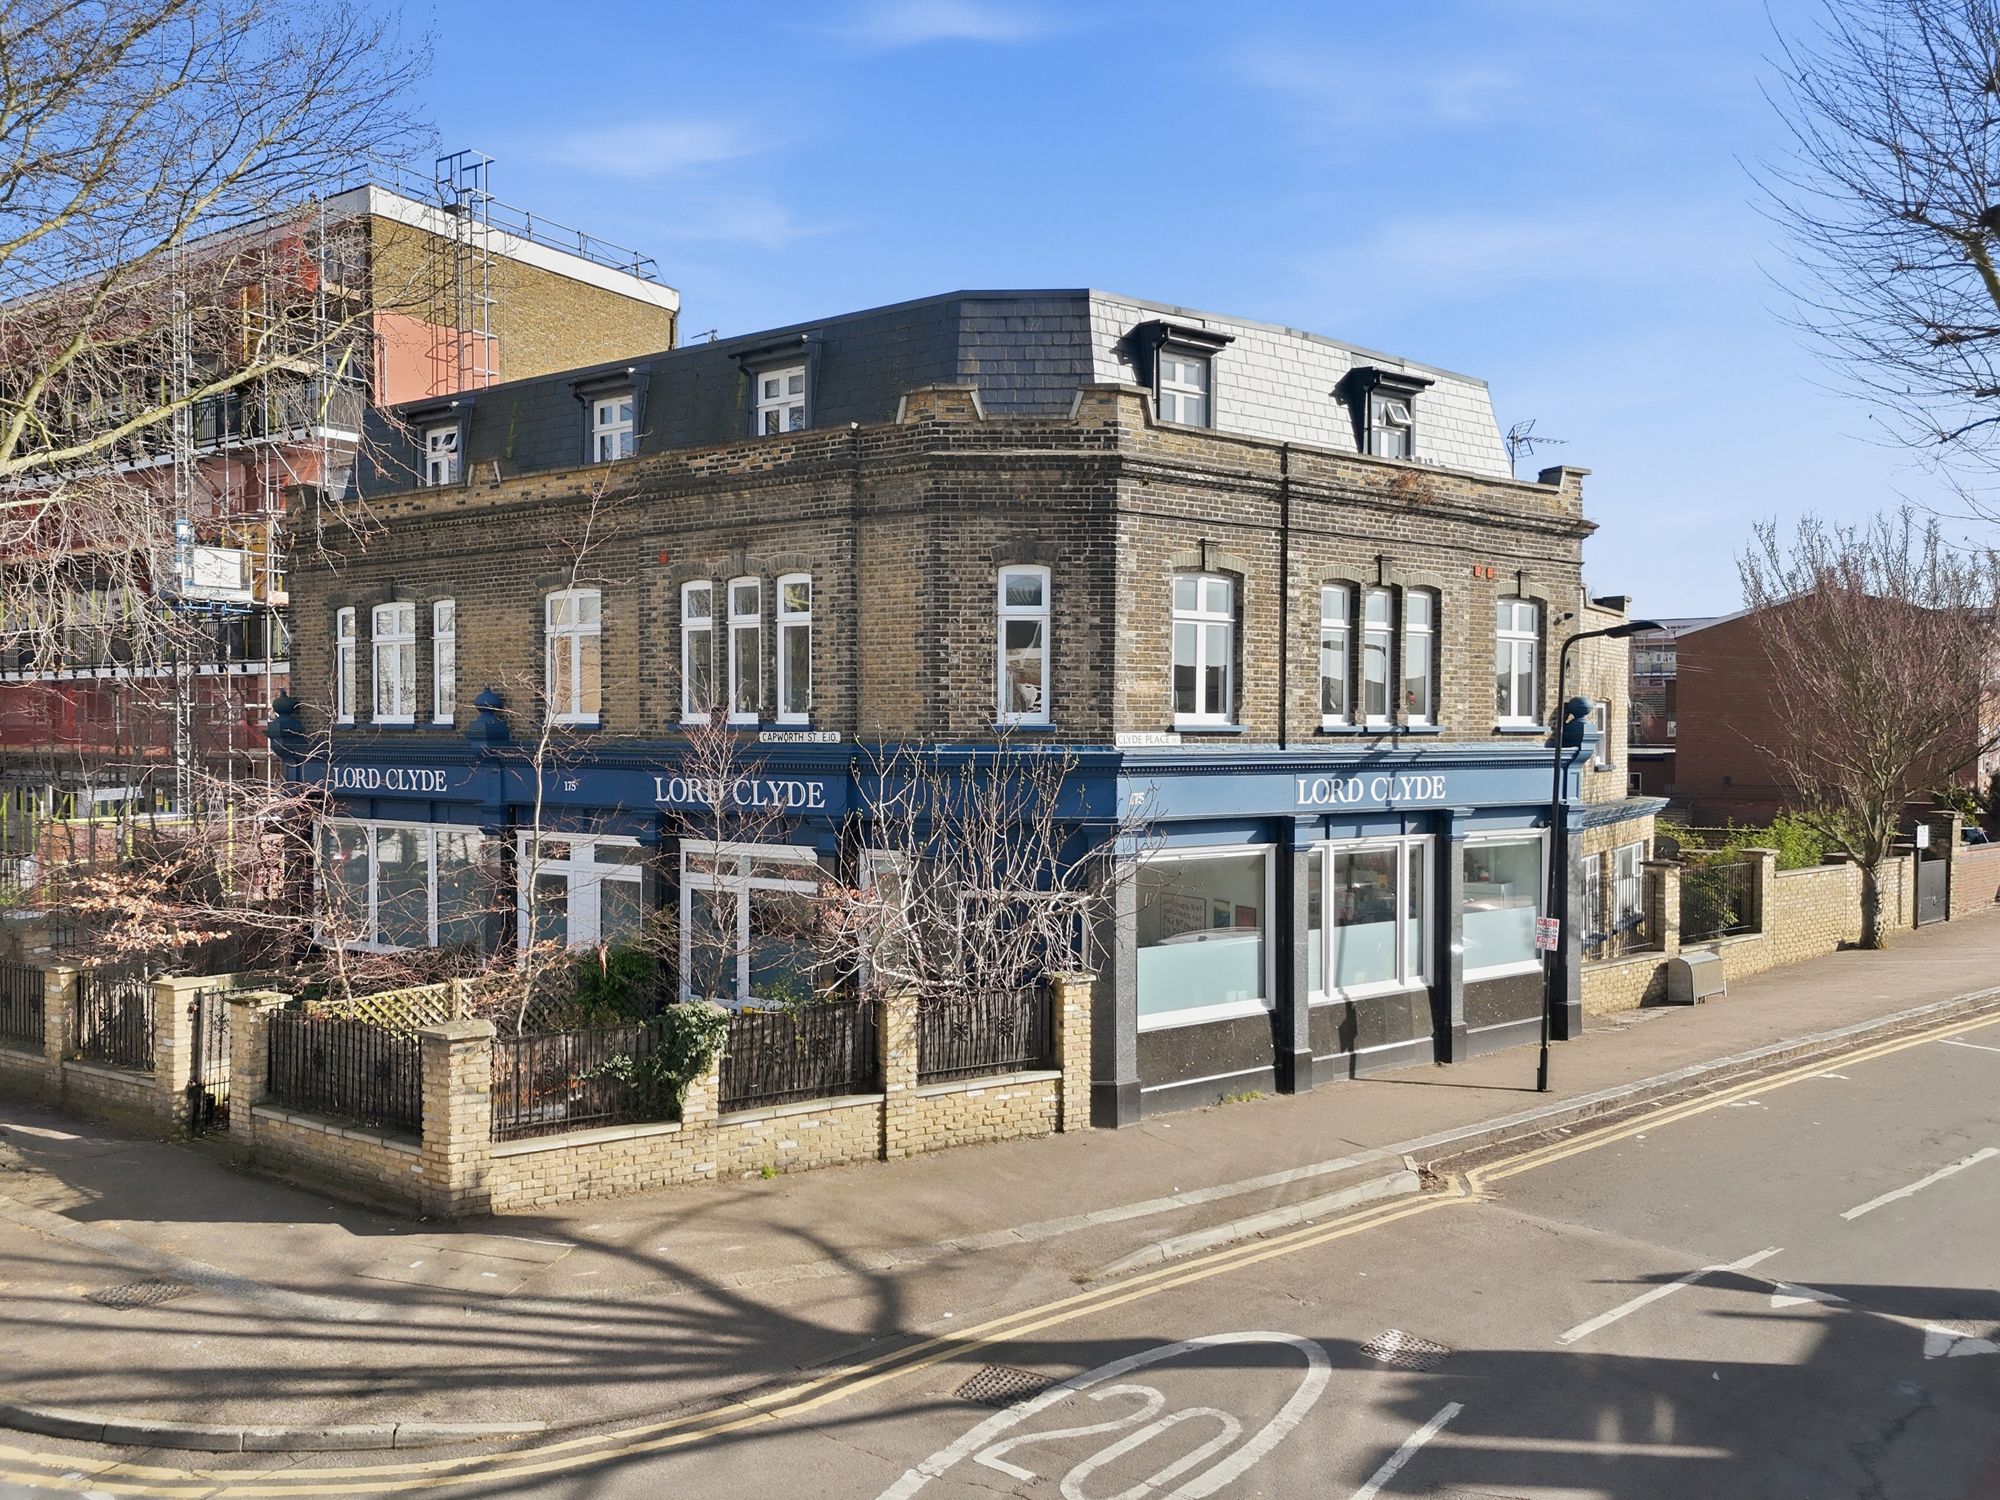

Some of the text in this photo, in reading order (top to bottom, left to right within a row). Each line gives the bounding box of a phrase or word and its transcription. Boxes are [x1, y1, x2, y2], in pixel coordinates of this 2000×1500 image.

[762, 732, 804, 742] CAPWORTH
[1117, 735, 1142, 745] CLYDE
[1145, 735, 1170, 745] PLACE
[333, 767, 447, 792] LORD CLYDE
[564, 780, 576, 791] 175
[1297, 775, 1446, 805] LORD CLYDE
[732, 779, 826, 808] CLYDE
[973, 1384, 1243, 1500] 20
